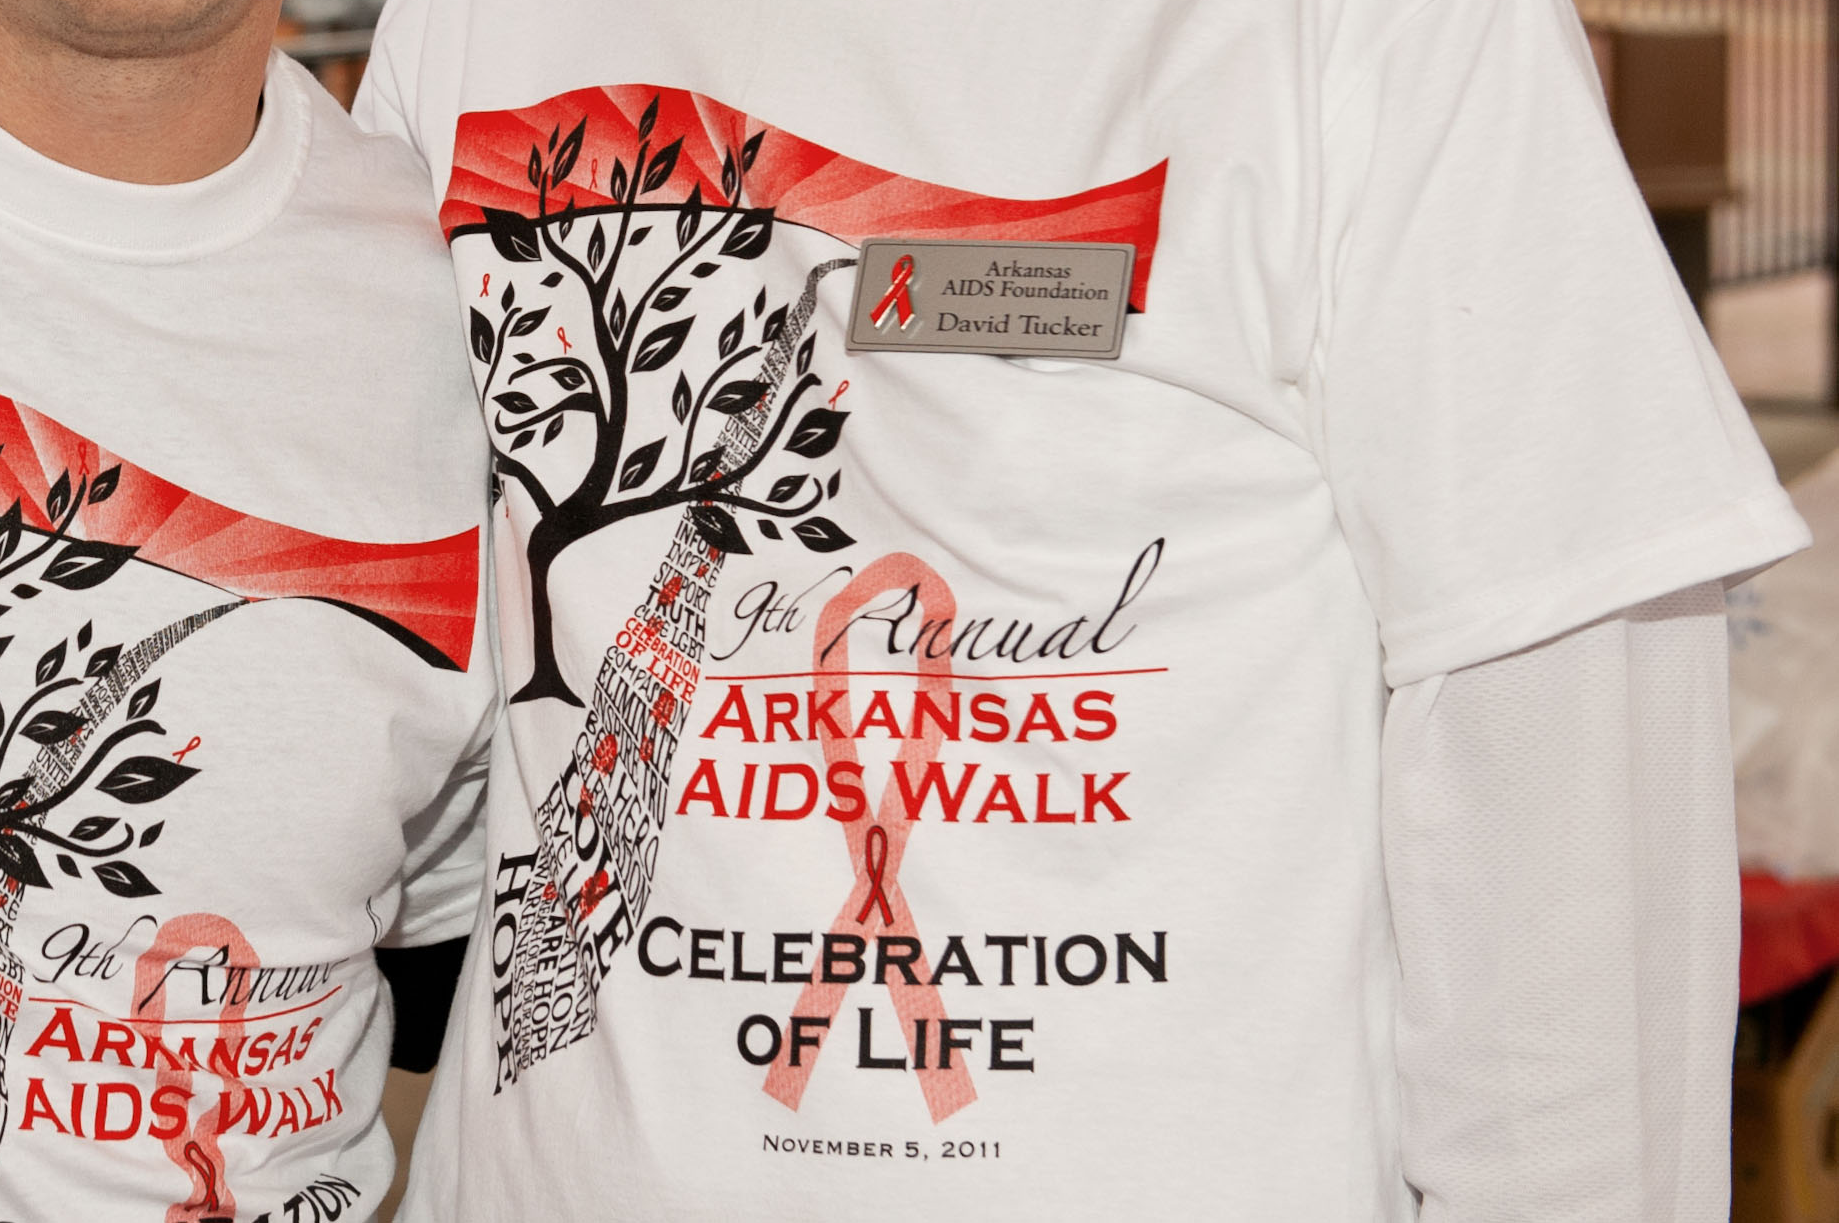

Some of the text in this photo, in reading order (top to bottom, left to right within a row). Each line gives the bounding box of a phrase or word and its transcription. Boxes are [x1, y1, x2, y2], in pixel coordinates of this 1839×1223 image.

[941, 279, 1109, 301] AIDS Foundation
[985, 260, 1072, 279] Arkansas
[937, 312, 1103, 337] David Tucker
[646, 584, 706, 642] TRUTH
[710, 537, 1165, 665] 9th Annual
[615, 630, 697, 706] OF LIFE
[625, 617, 701, 685] CELEBRATION
[669, 626, 705, 664] LGBT
[606, 645, 692, 738] COMPASON
[699, 684, 1118, 744] ARKANSAS
[675, 758, 1131, 824] AIDS WALK
[560, 748, 635, 980] LOVE
[33, 915, 158, 983] 9th
[513, 848, 548, 998] WARENESS
[638, 916, 1169, 986] CELEBRATION
[492, 845, 541, 1097] HOPE
[530, 977, 554, 1066] HOPE
[736, 1007, 1035, 1073] OF LIFE
[18, 1068, 344, 1141] AIDS WALK
[762, 1134, 1002, 1163] NOVEMBER 5, 2011
